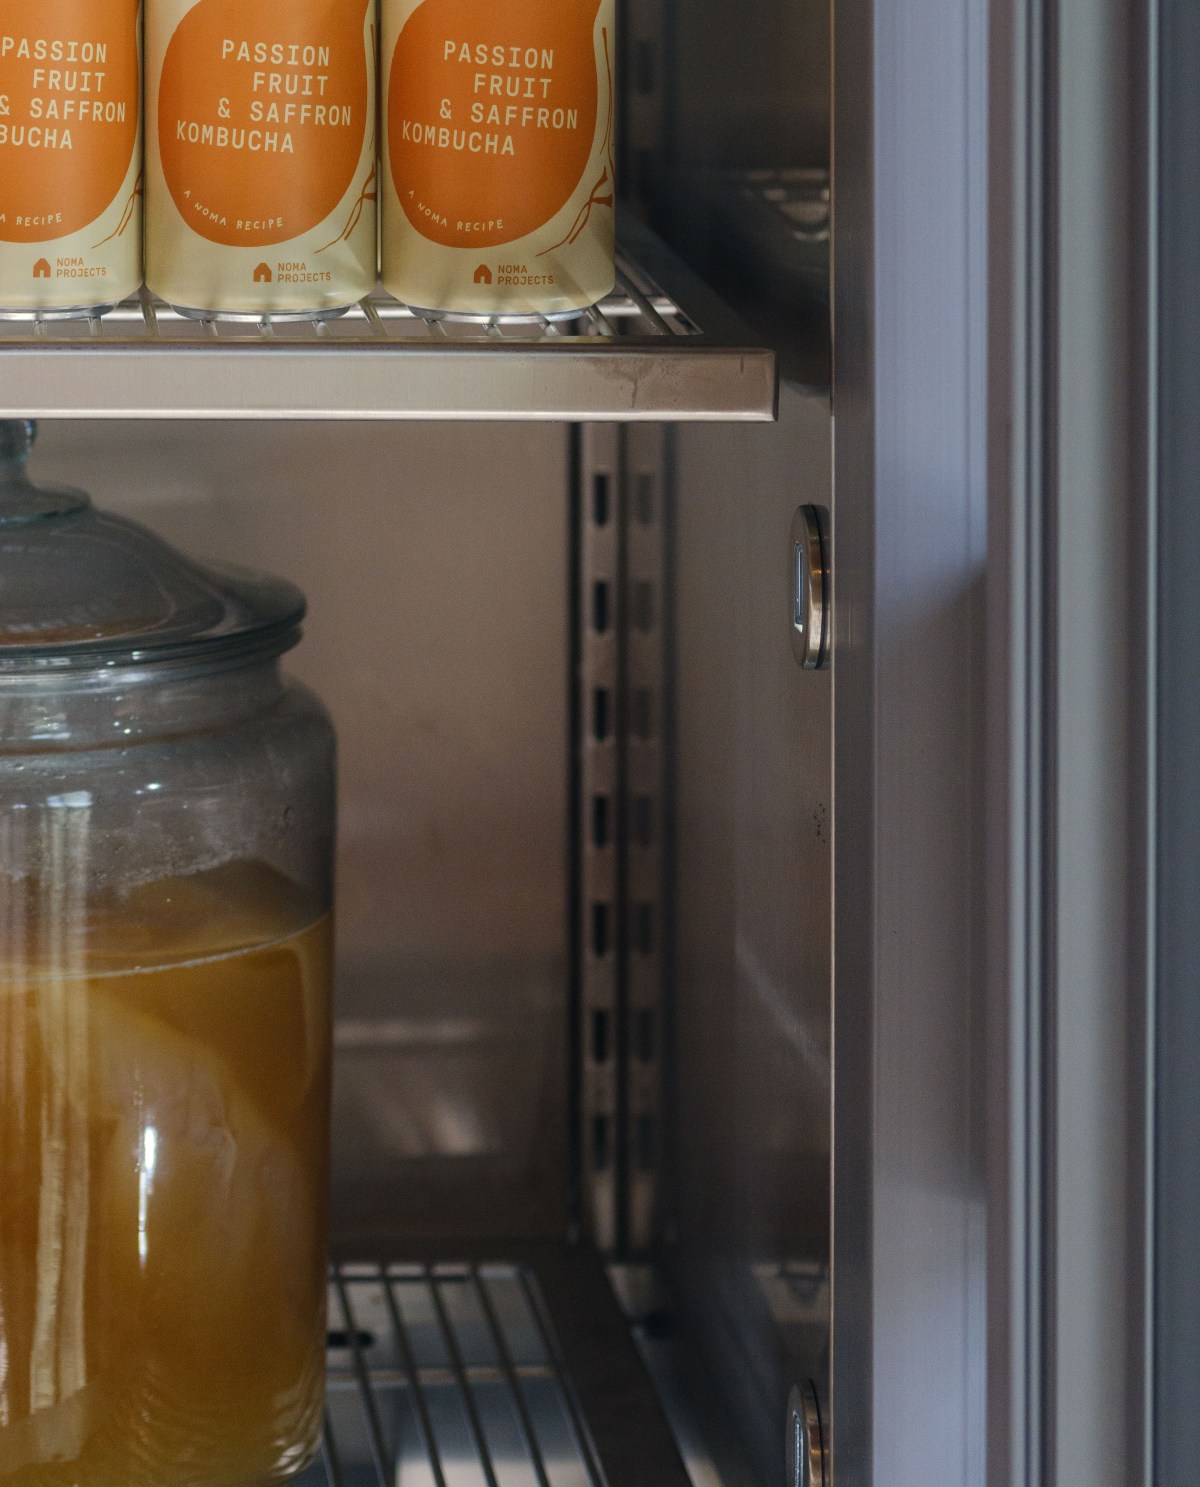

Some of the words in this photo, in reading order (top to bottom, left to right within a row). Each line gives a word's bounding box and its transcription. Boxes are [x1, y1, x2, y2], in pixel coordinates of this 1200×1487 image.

[222, 39, 330, 67] PASSION
[444, 40, 554, 70] PASSION
[253, 71, 329, 95] FRUIT
[473, 73, 552, 99] FRUIT
[217, 98, 232, 119] &
[250, 100, 352, 126] SAFFRON
[439, 99, 453, 120] &
[471, 102, 578, 130] SAFFRON
[176, 119, 294, 154] KOMBUCHA
[402, 120, 515, 156] KOMBUCHA
[278, 262, 307, 272] NOMA
[278, 271, 331, 283] PROJECTS
[497, 275, 554, 285] PROJECTS
[498, 264, 528, 274] NOMA
